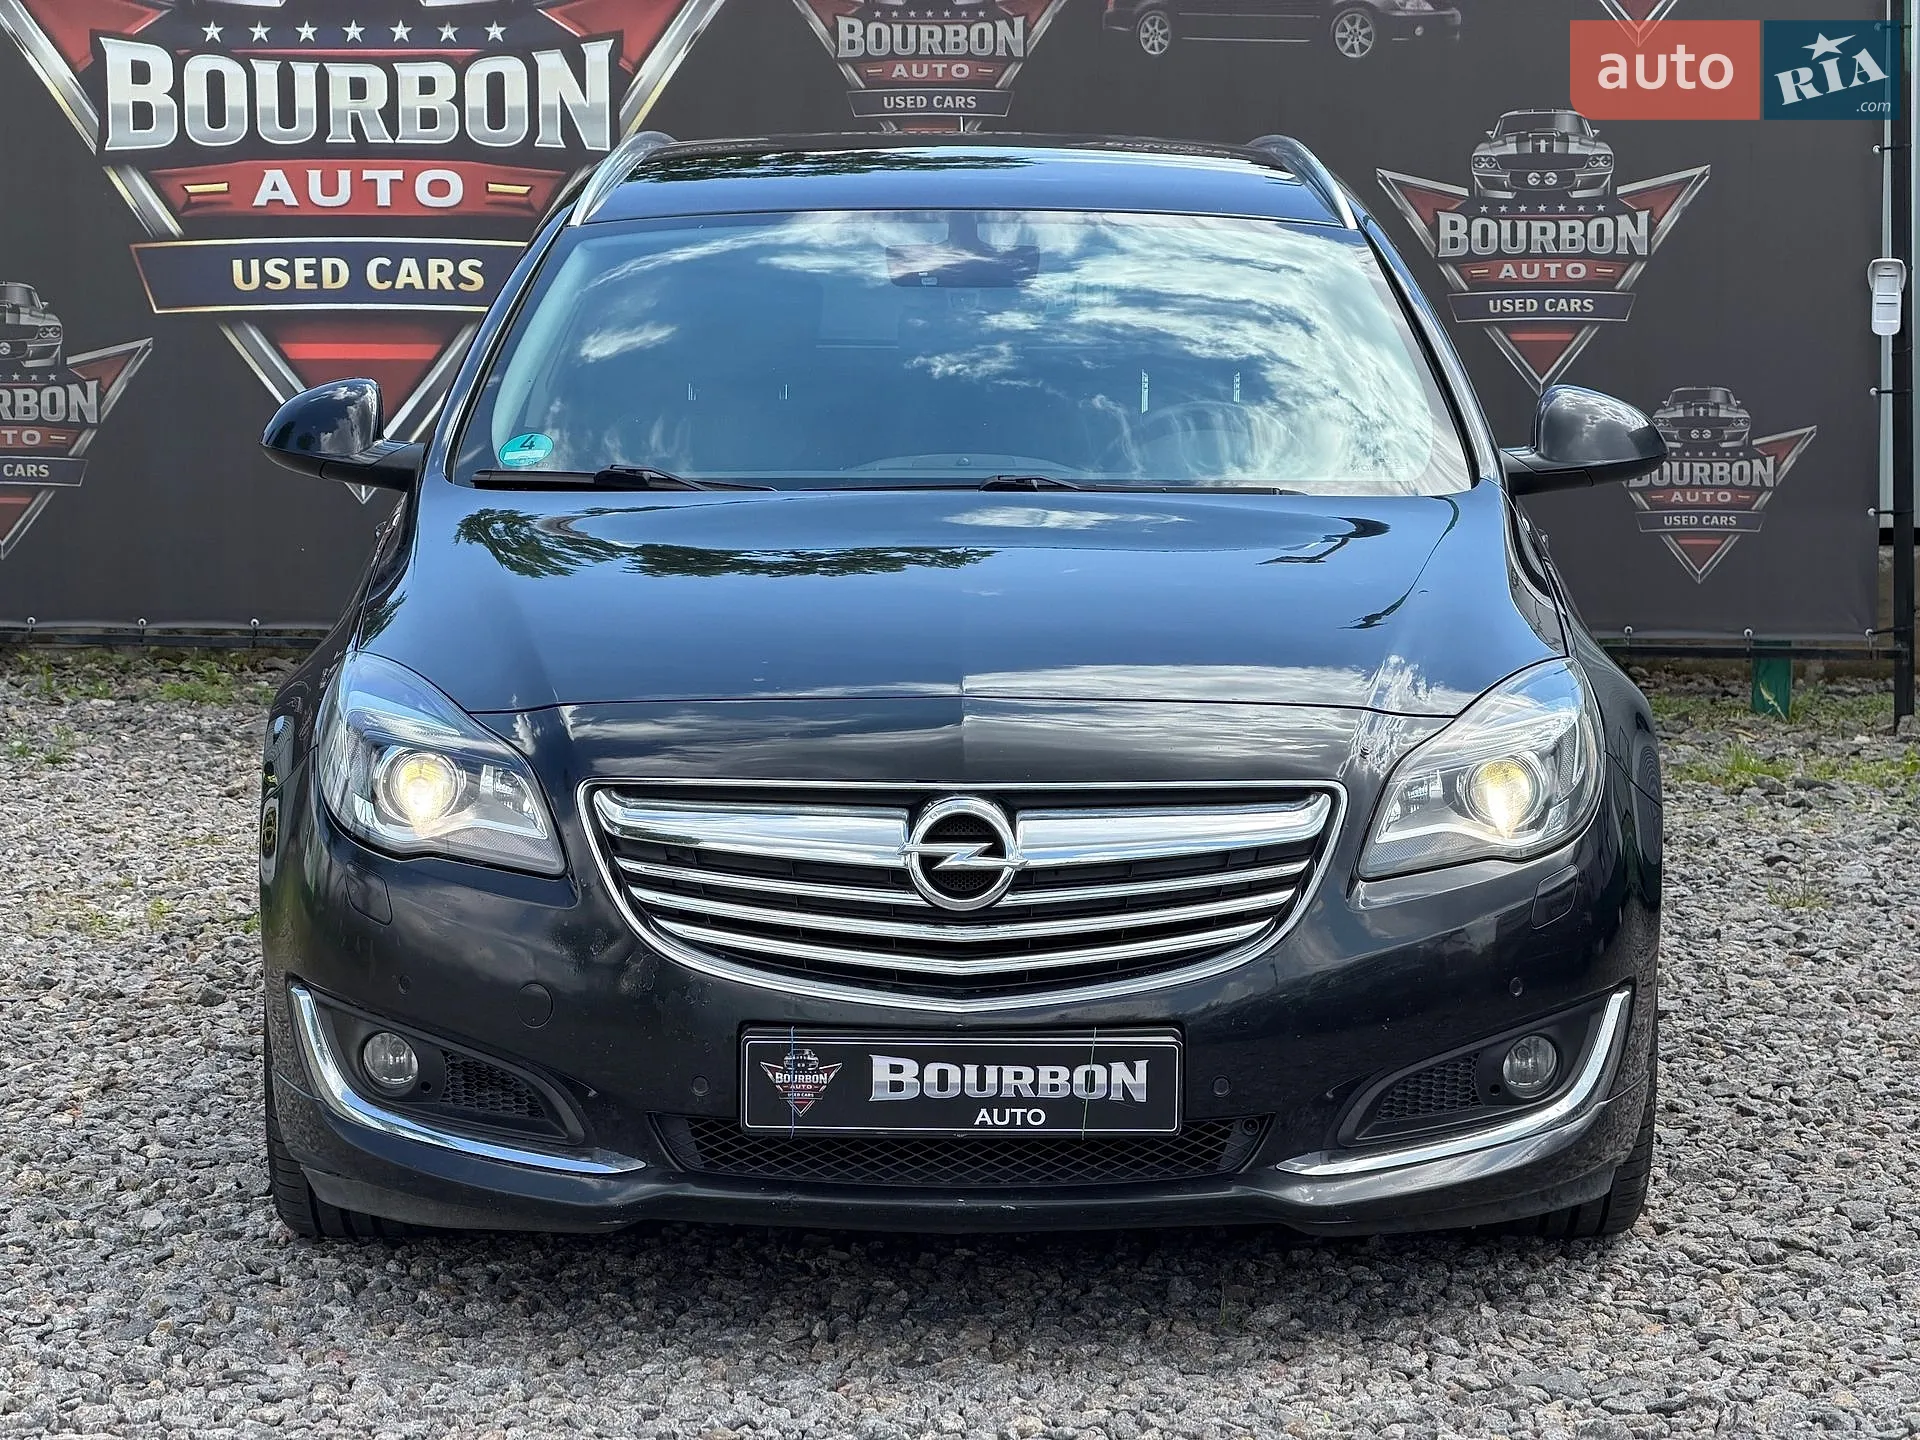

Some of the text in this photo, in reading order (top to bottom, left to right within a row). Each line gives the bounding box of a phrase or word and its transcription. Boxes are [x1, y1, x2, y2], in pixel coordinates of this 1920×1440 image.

[835, 16, 1025, 58] BOURBON
[892, 64, 970, 78] AUTO
[100, 37, 614, 151] BOURBON
[883, 95, 977, 110] USED CARS
[252, 169, 464, 207] AUTO
[1437, 210, 1650, 257] BOURBON
[231, 257, 485, 291] USED CARS
[1498, 263, 1587, 279] AUTO
[1489, 298, 1594, 313] USED CARS
[521, 435, 535, 449] 4
[3, 464, 49, 477] CARS
[1629, 456, 1776, 487] OURBON
[1671, 491, 1732, 502] AUTO
[1663, 516, 1737, 526] USED CARS
[868, 1054, 1149, 1102] BOURBON
[974, 1108, 1046, 1126] AUTO
